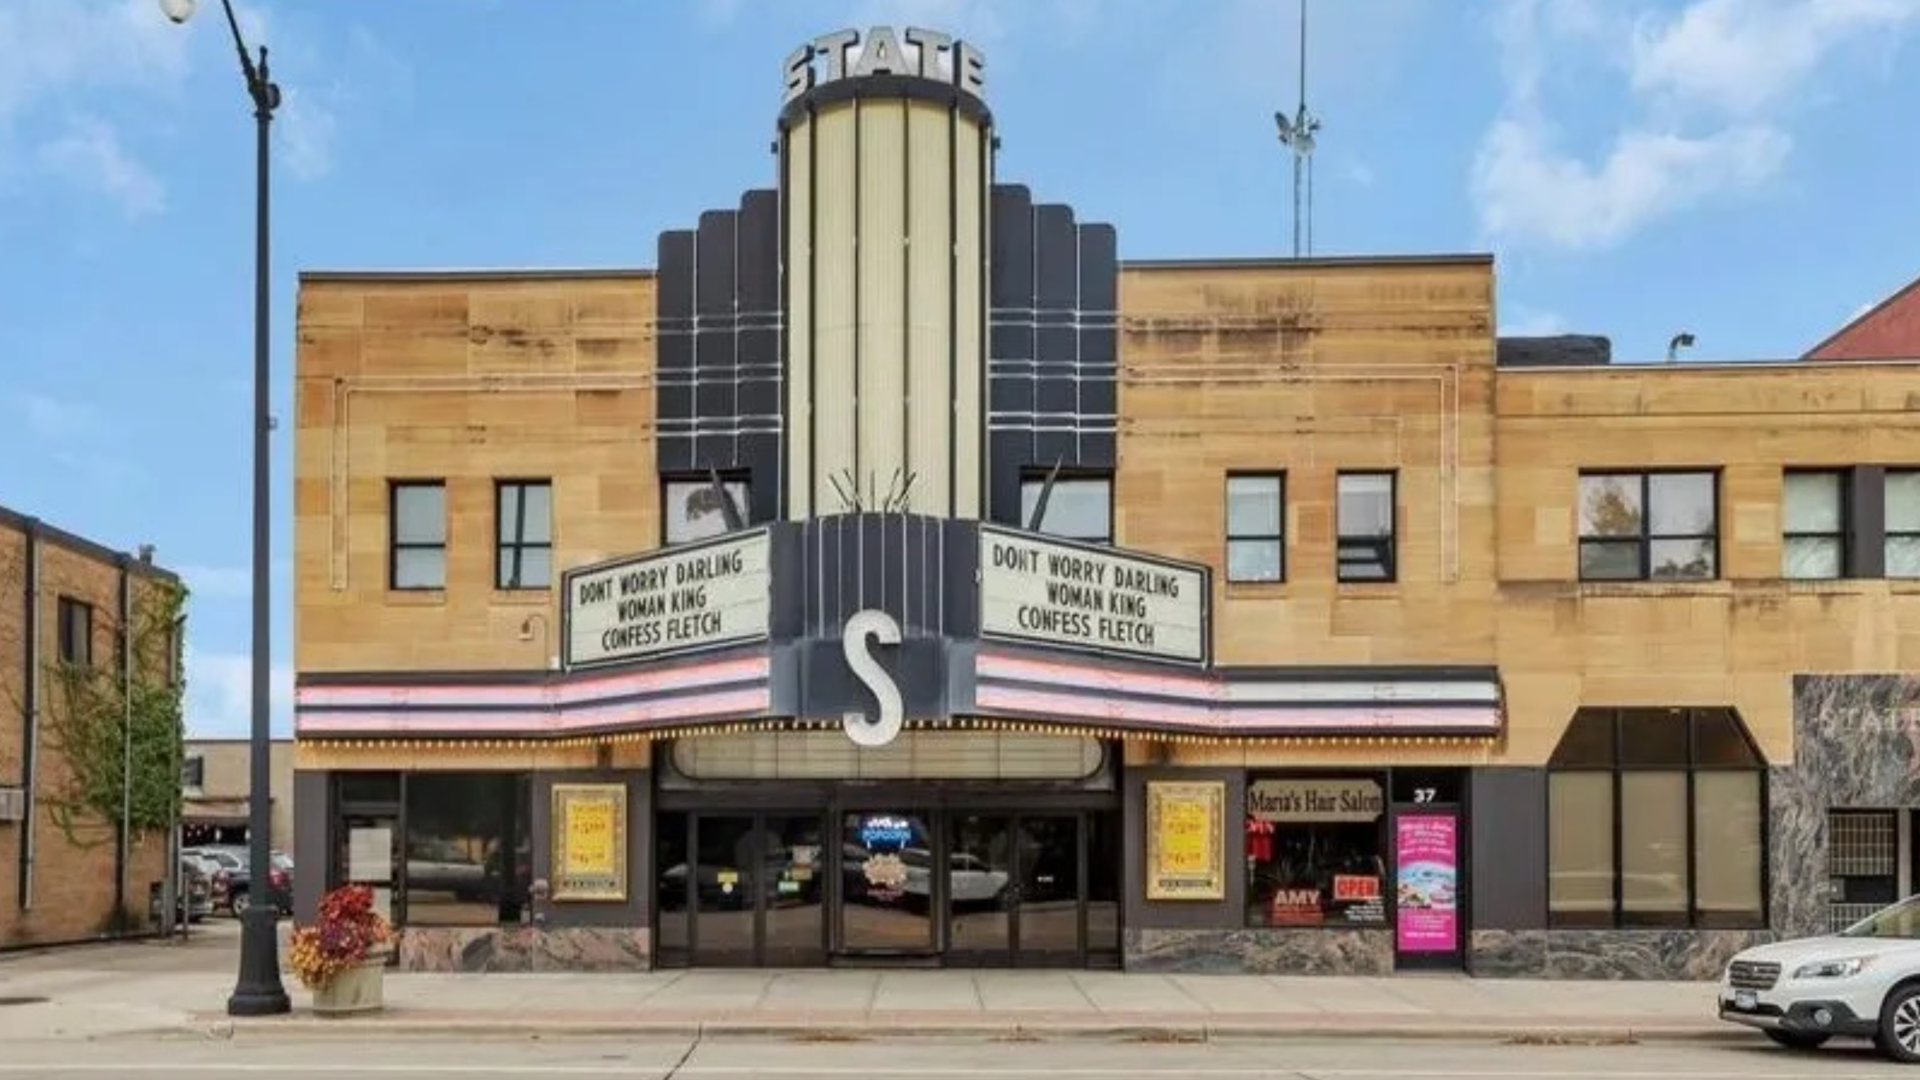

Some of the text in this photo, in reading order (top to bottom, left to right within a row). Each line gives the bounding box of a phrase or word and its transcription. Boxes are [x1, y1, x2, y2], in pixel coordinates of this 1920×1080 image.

[783, 26, 986, 104] STATE
[580, 549, 743, 605] DONT WORRY DARLING
[992, 543, 1179, 598] DONT WORRY DARLING
[617, 584, 708, 622] WOMAN KING
[1046, 581, 1147, 619] WOMAN KING
[601, 610, 722, 652] CONFESS FLETCH
[1018, 606, 1155, 646] CONFESS FLETCH
[843, 609, 904, 746] S
[1249, 788, 1380, 813] Maria's Hair Salon
[1413, 787, 1437, 804] 37
[1275, 889, 1320, 905] AMY
[1336, 879, 1376, 898] OPEN
